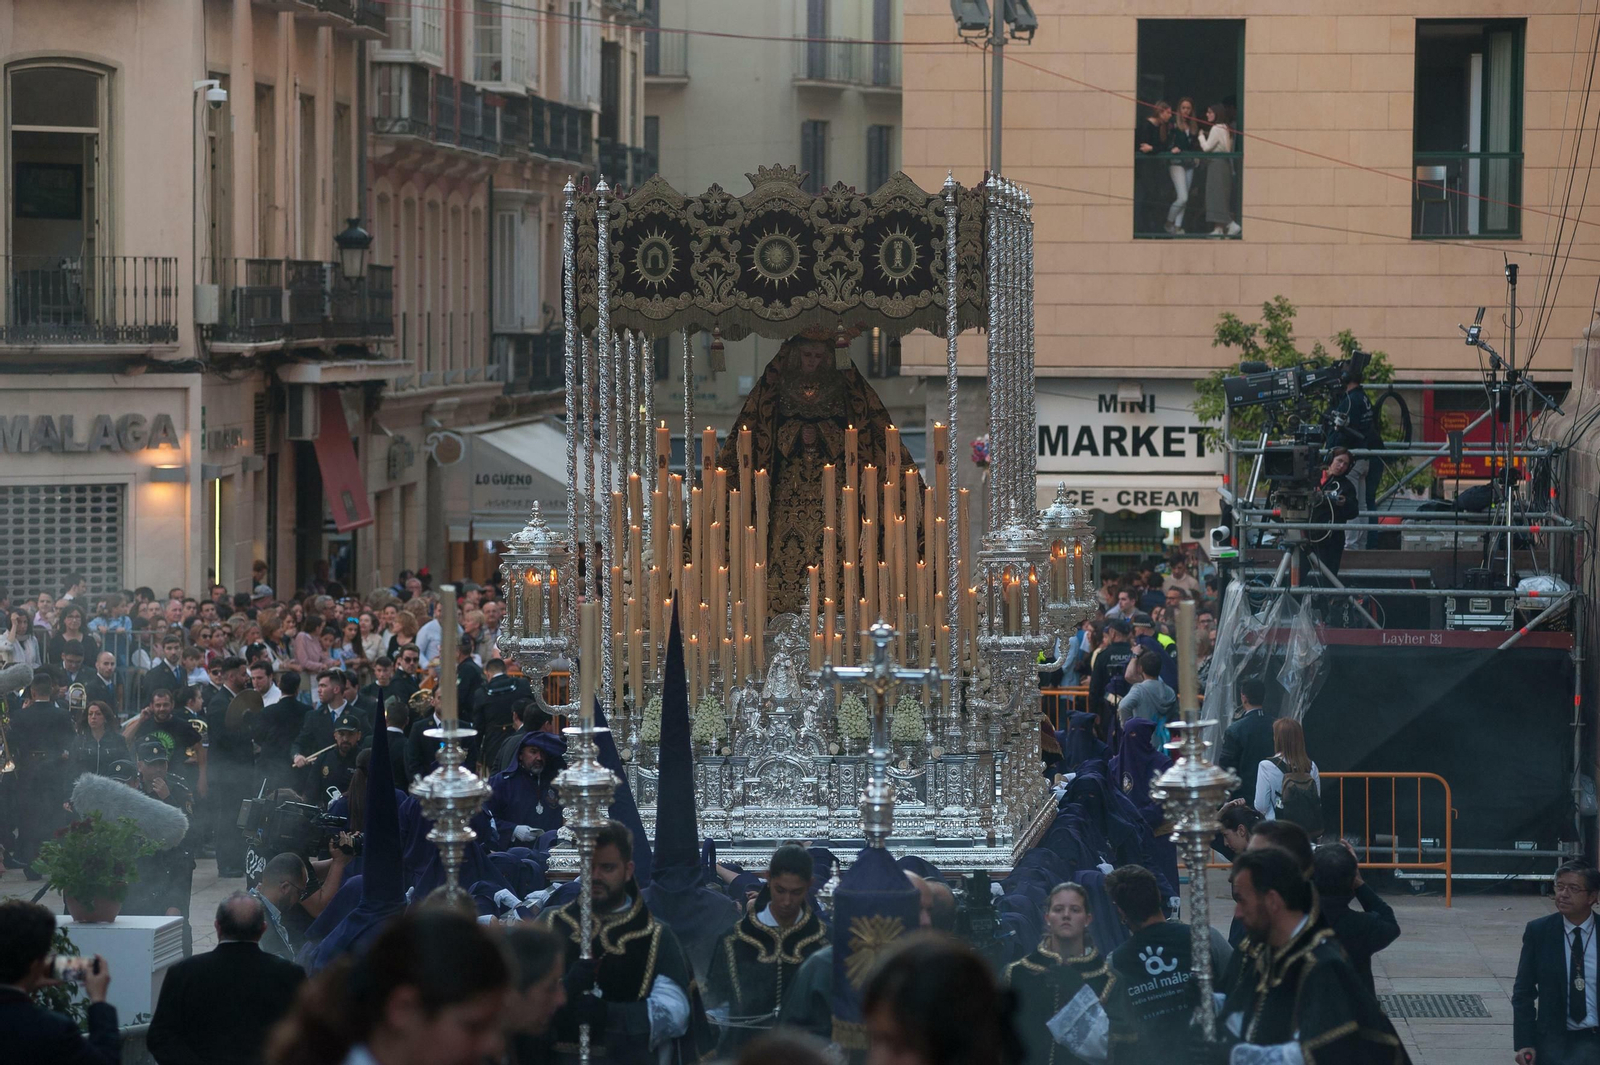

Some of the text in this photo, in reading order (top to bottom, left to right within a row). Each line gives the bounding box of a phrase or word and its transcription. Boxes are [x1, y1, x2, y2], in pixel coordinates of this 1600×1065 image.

[1098, 394, 1155, 413] MINI
[0, 413, 181, 451] MALAGA
[1038, 425, 1213, 457] MARKET
[475, 474, 489, 485] LO
[1064, 490, 1094, 506] CE
[1116, 490, 1199, 507] CREAM
[1383, 633, 1425, 645] Layher
[1128, 978, 1158, 996] canal
